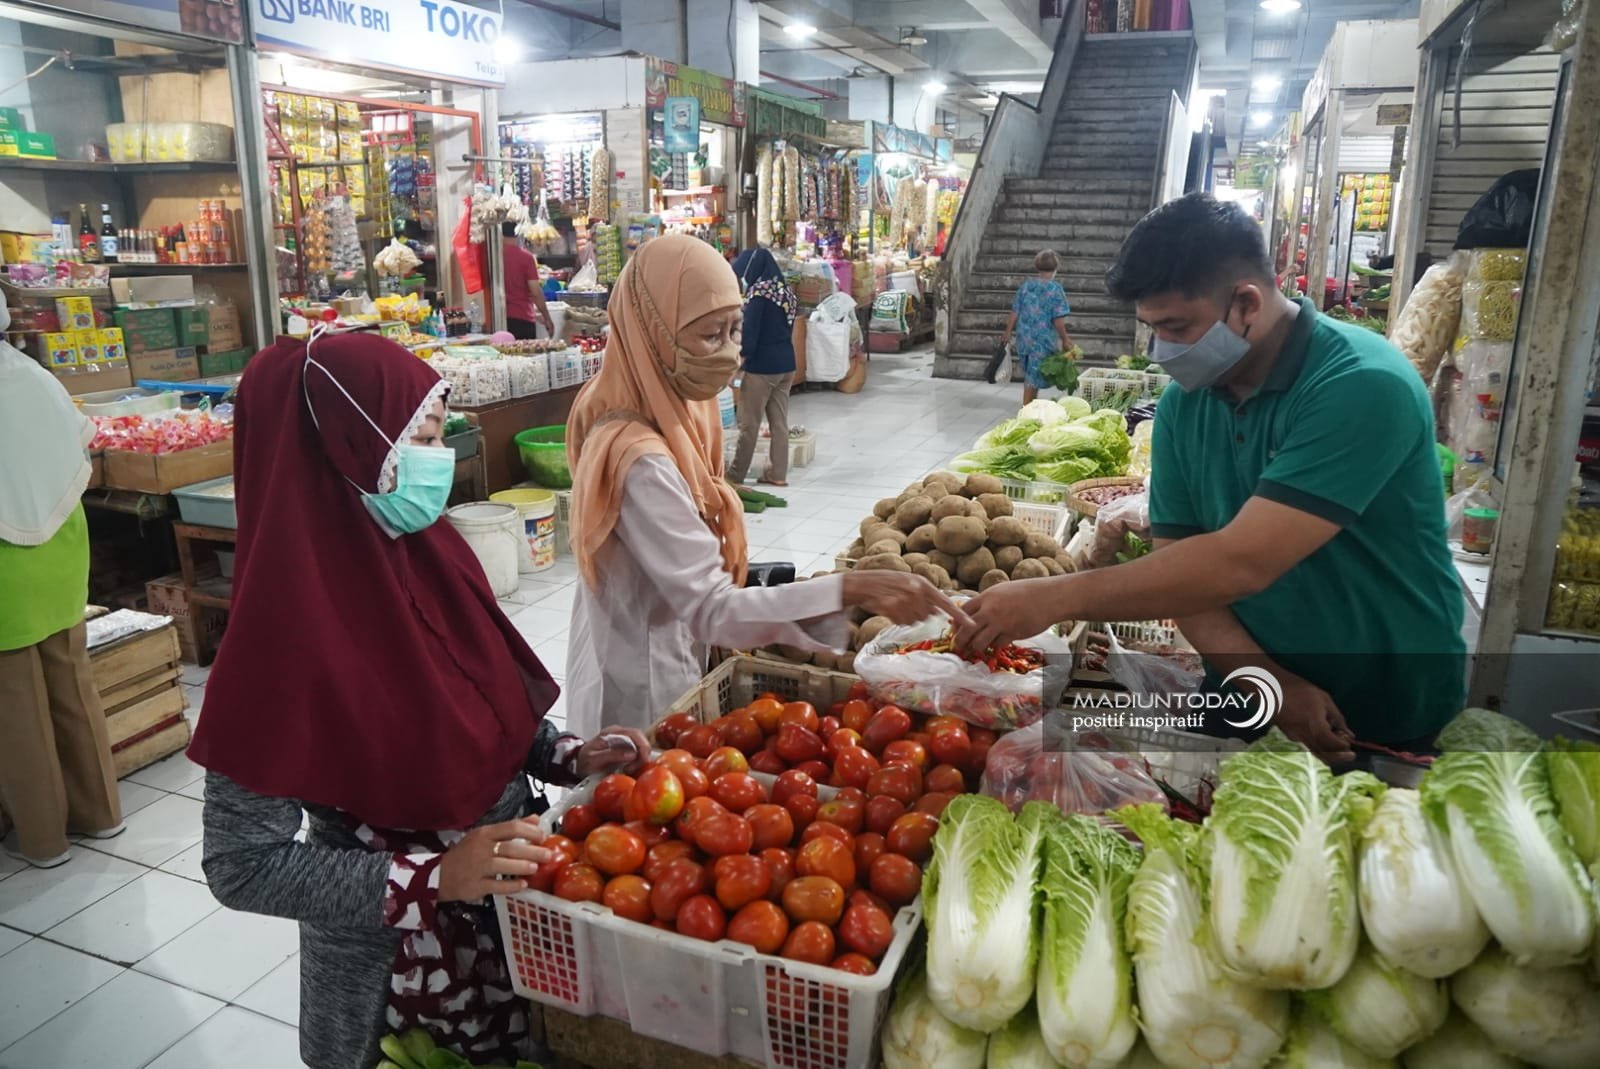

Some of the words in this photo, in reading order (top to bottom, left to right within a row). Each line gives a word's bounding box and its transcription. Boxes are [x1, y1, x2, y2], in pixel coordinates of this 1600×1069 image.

[297, 0, 357, 26] BANK
[361, 9, 391, 33] BRI
[420, 0, 496, 44] TOKO
